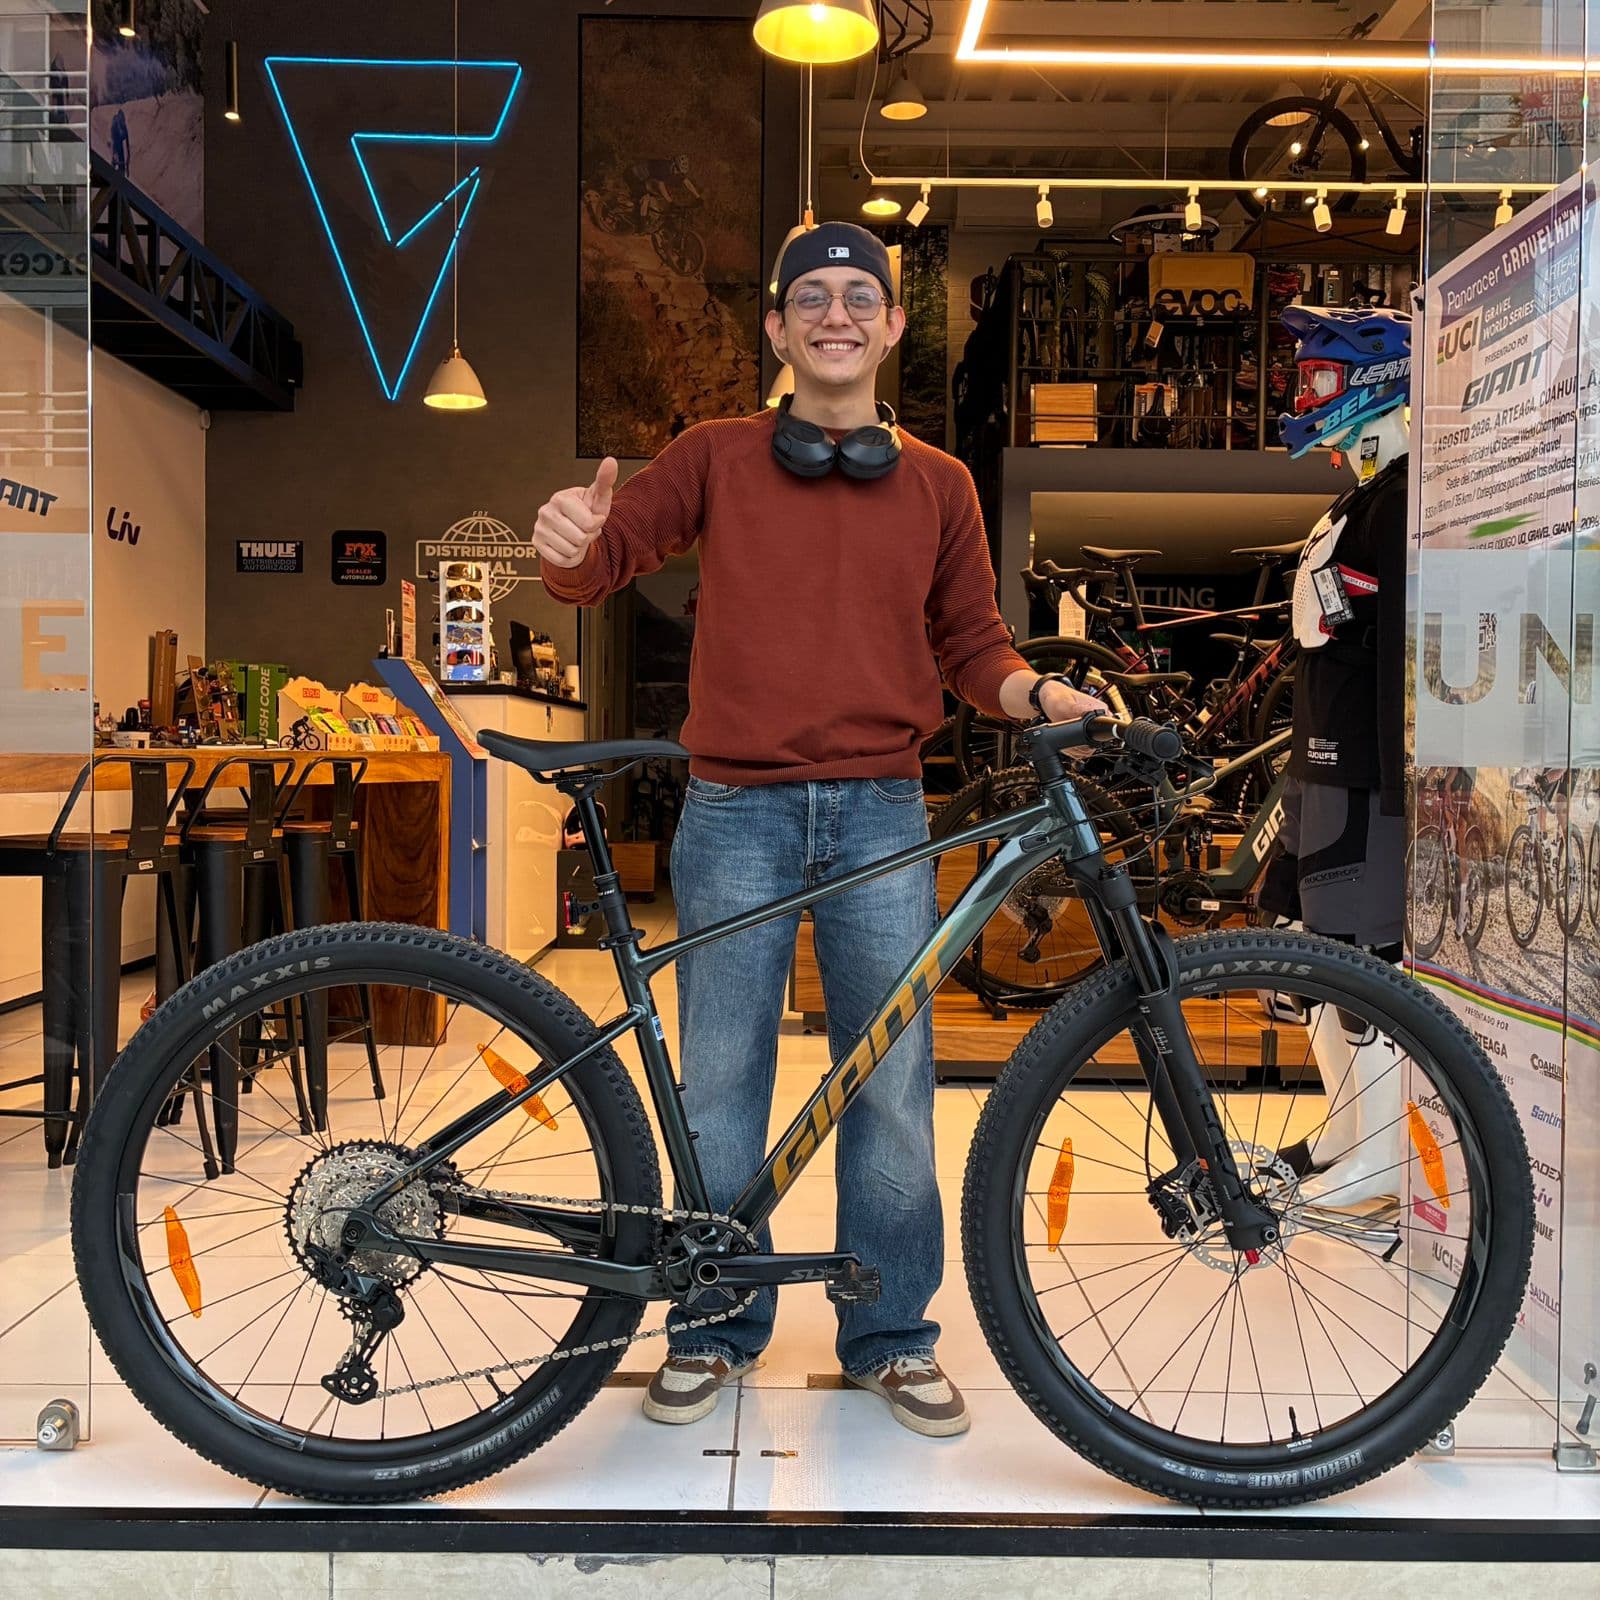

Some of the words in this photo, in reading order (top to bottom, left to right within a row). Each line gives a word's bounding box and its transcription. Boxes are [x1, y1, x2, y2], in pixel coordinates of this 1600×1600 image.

[1544, 246, 1580, 281] ARTEAG
[1509, 300, 1535, 326] SERIES
[1444, 316, 1479, 360] UCI
[1461, 339, 1553, 413] GIANT
[106, 506, 141, 545] Liv
[239, 542, 297, 558] THULE
[344, 543, 377, 558] FOX
[424, 544, 537, 559] DISTRIBUIDOR
[260, 666, 271, 707] CORE
[1252, 797, 1286, 863] GIA
[1179, 959, 1313, 984] MAXXIS
[201, 956, 331, 1020] MAXXIS
[772, 923, 953, 1197] GIANT
[1473, 1031, 1508, 1059] TEAGA
[1247, 1468, 1300, 1490] RACE
[1303, 1450, 1362, 1480] REKON
